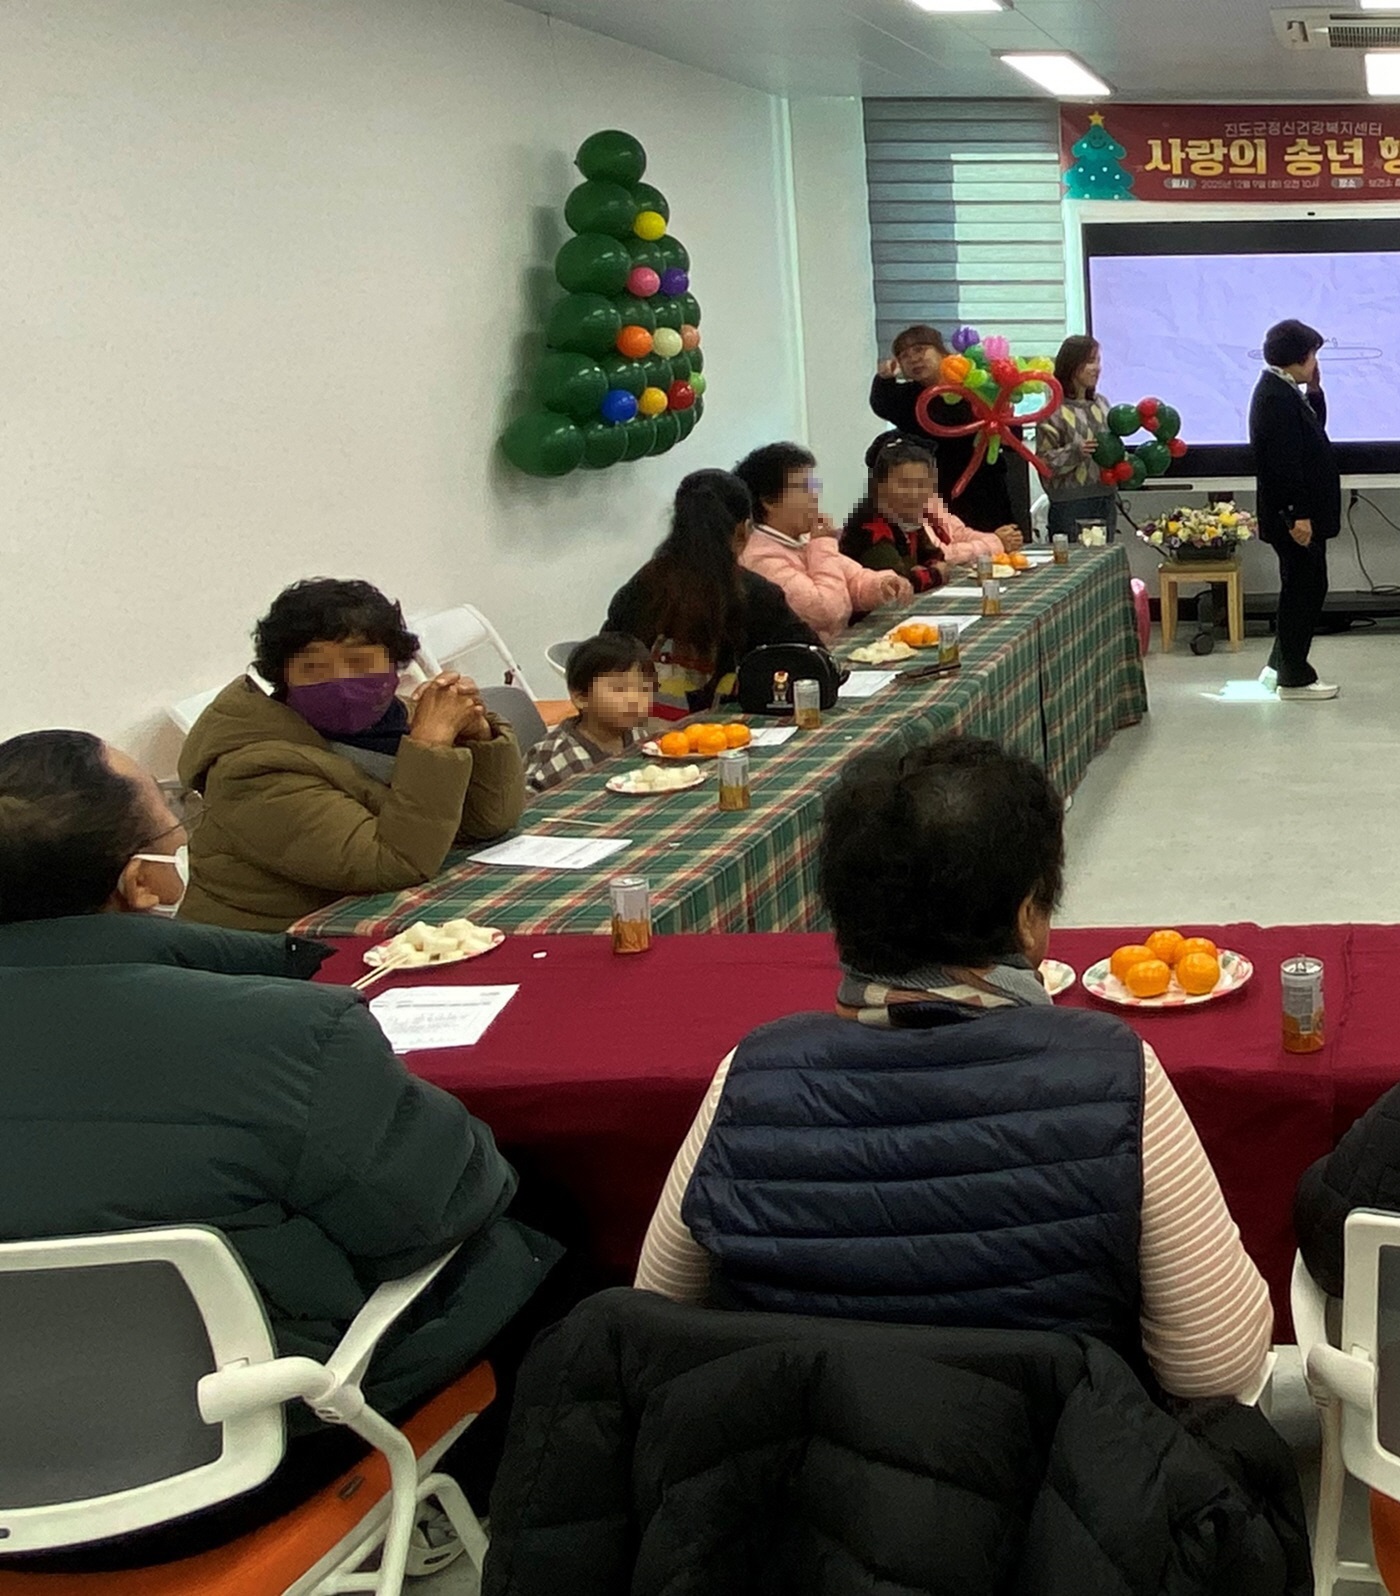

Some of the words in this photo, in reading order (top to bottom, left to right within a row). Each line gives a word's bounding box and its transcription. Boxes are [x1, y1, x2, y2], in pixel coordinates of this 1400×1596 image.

[1224, 121, 1383, 138] 진도군정신건강복지센터
[1144, 138, 1268, 177] 사랑의
[1284, 136, 1365, 177] 송년
[1171, 177, 1190, 190] 일시
